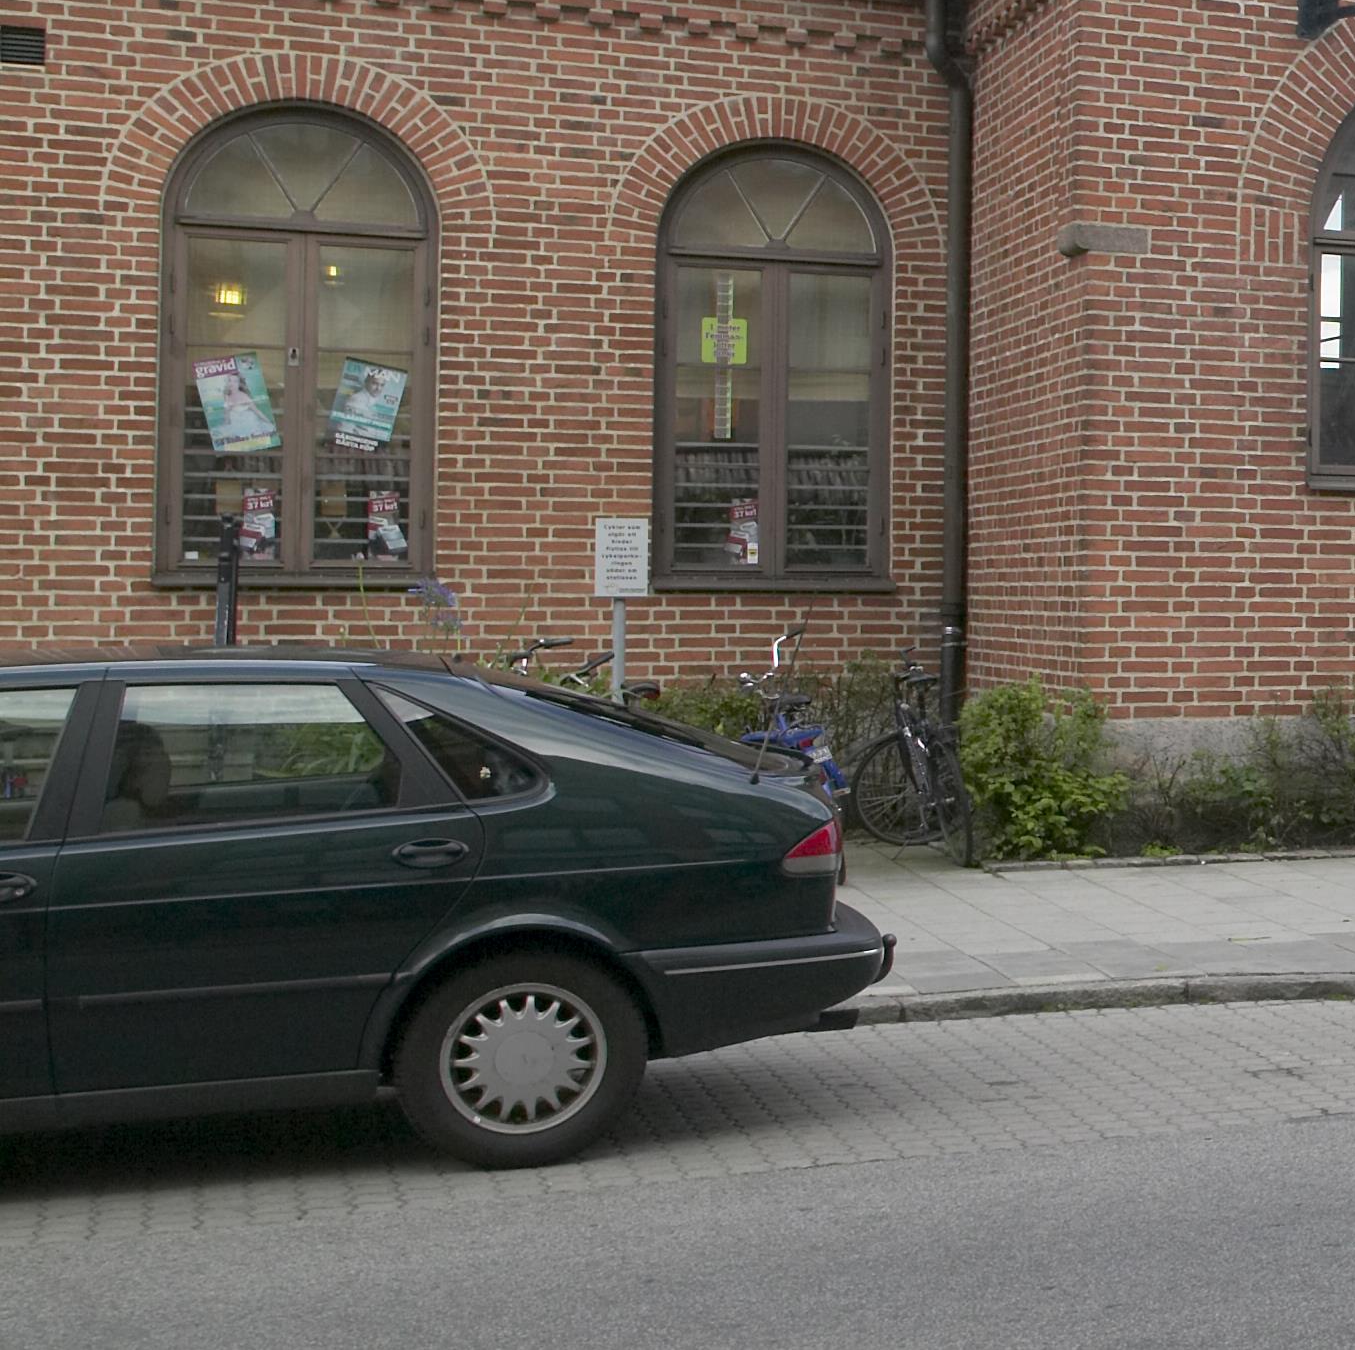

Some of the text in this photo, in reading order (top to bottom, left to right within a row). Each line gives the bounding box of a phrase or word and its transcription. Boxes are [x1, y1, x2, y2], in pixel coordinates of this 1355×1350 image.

[195, 356, 237, 379] gravid
[364, 366, 402, 384] MAN
[247, 500, 259, 510] 37
[372, 503, 384, 512] 37
[734, 510, 744, 519] 37
